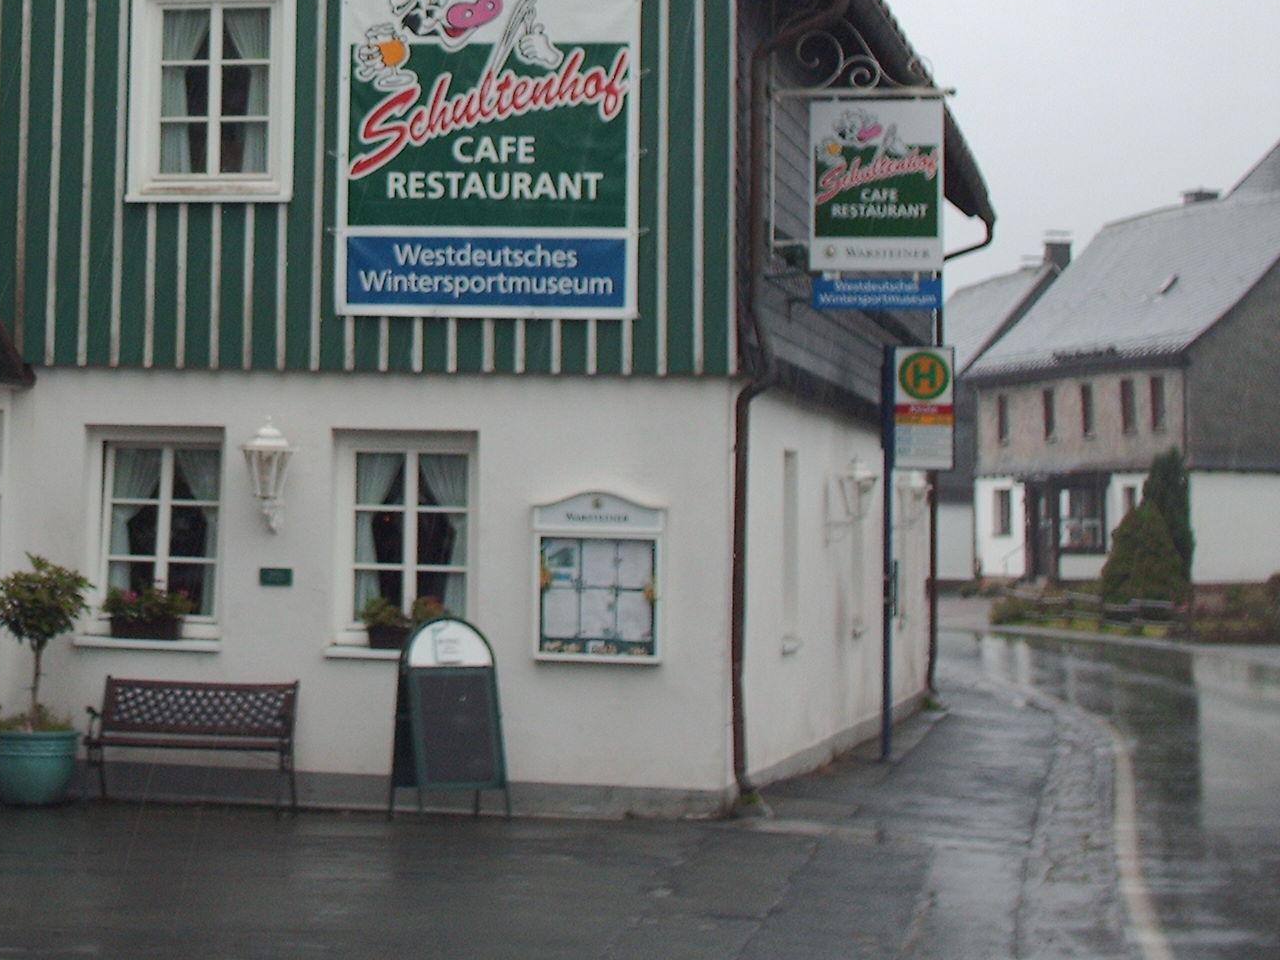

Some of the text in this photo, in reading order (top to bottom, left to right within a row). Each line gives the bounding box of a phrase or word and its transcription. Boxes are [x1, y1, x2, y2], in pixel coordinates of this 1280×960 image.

[348, 48, 630, 177] Schultenhof
[453, 136, 536, 163] CAFE
[387, 172, 604, 200] RESTAURANT
[861, 189, 898, 201] CAFE
[831, 203, 928, 218] RESTAURANT
[393, 244, 578, 268] Westdeutsches
[360, 271, 613, 297] Wintersportmuseum
[913, 362, 937, 388] H
